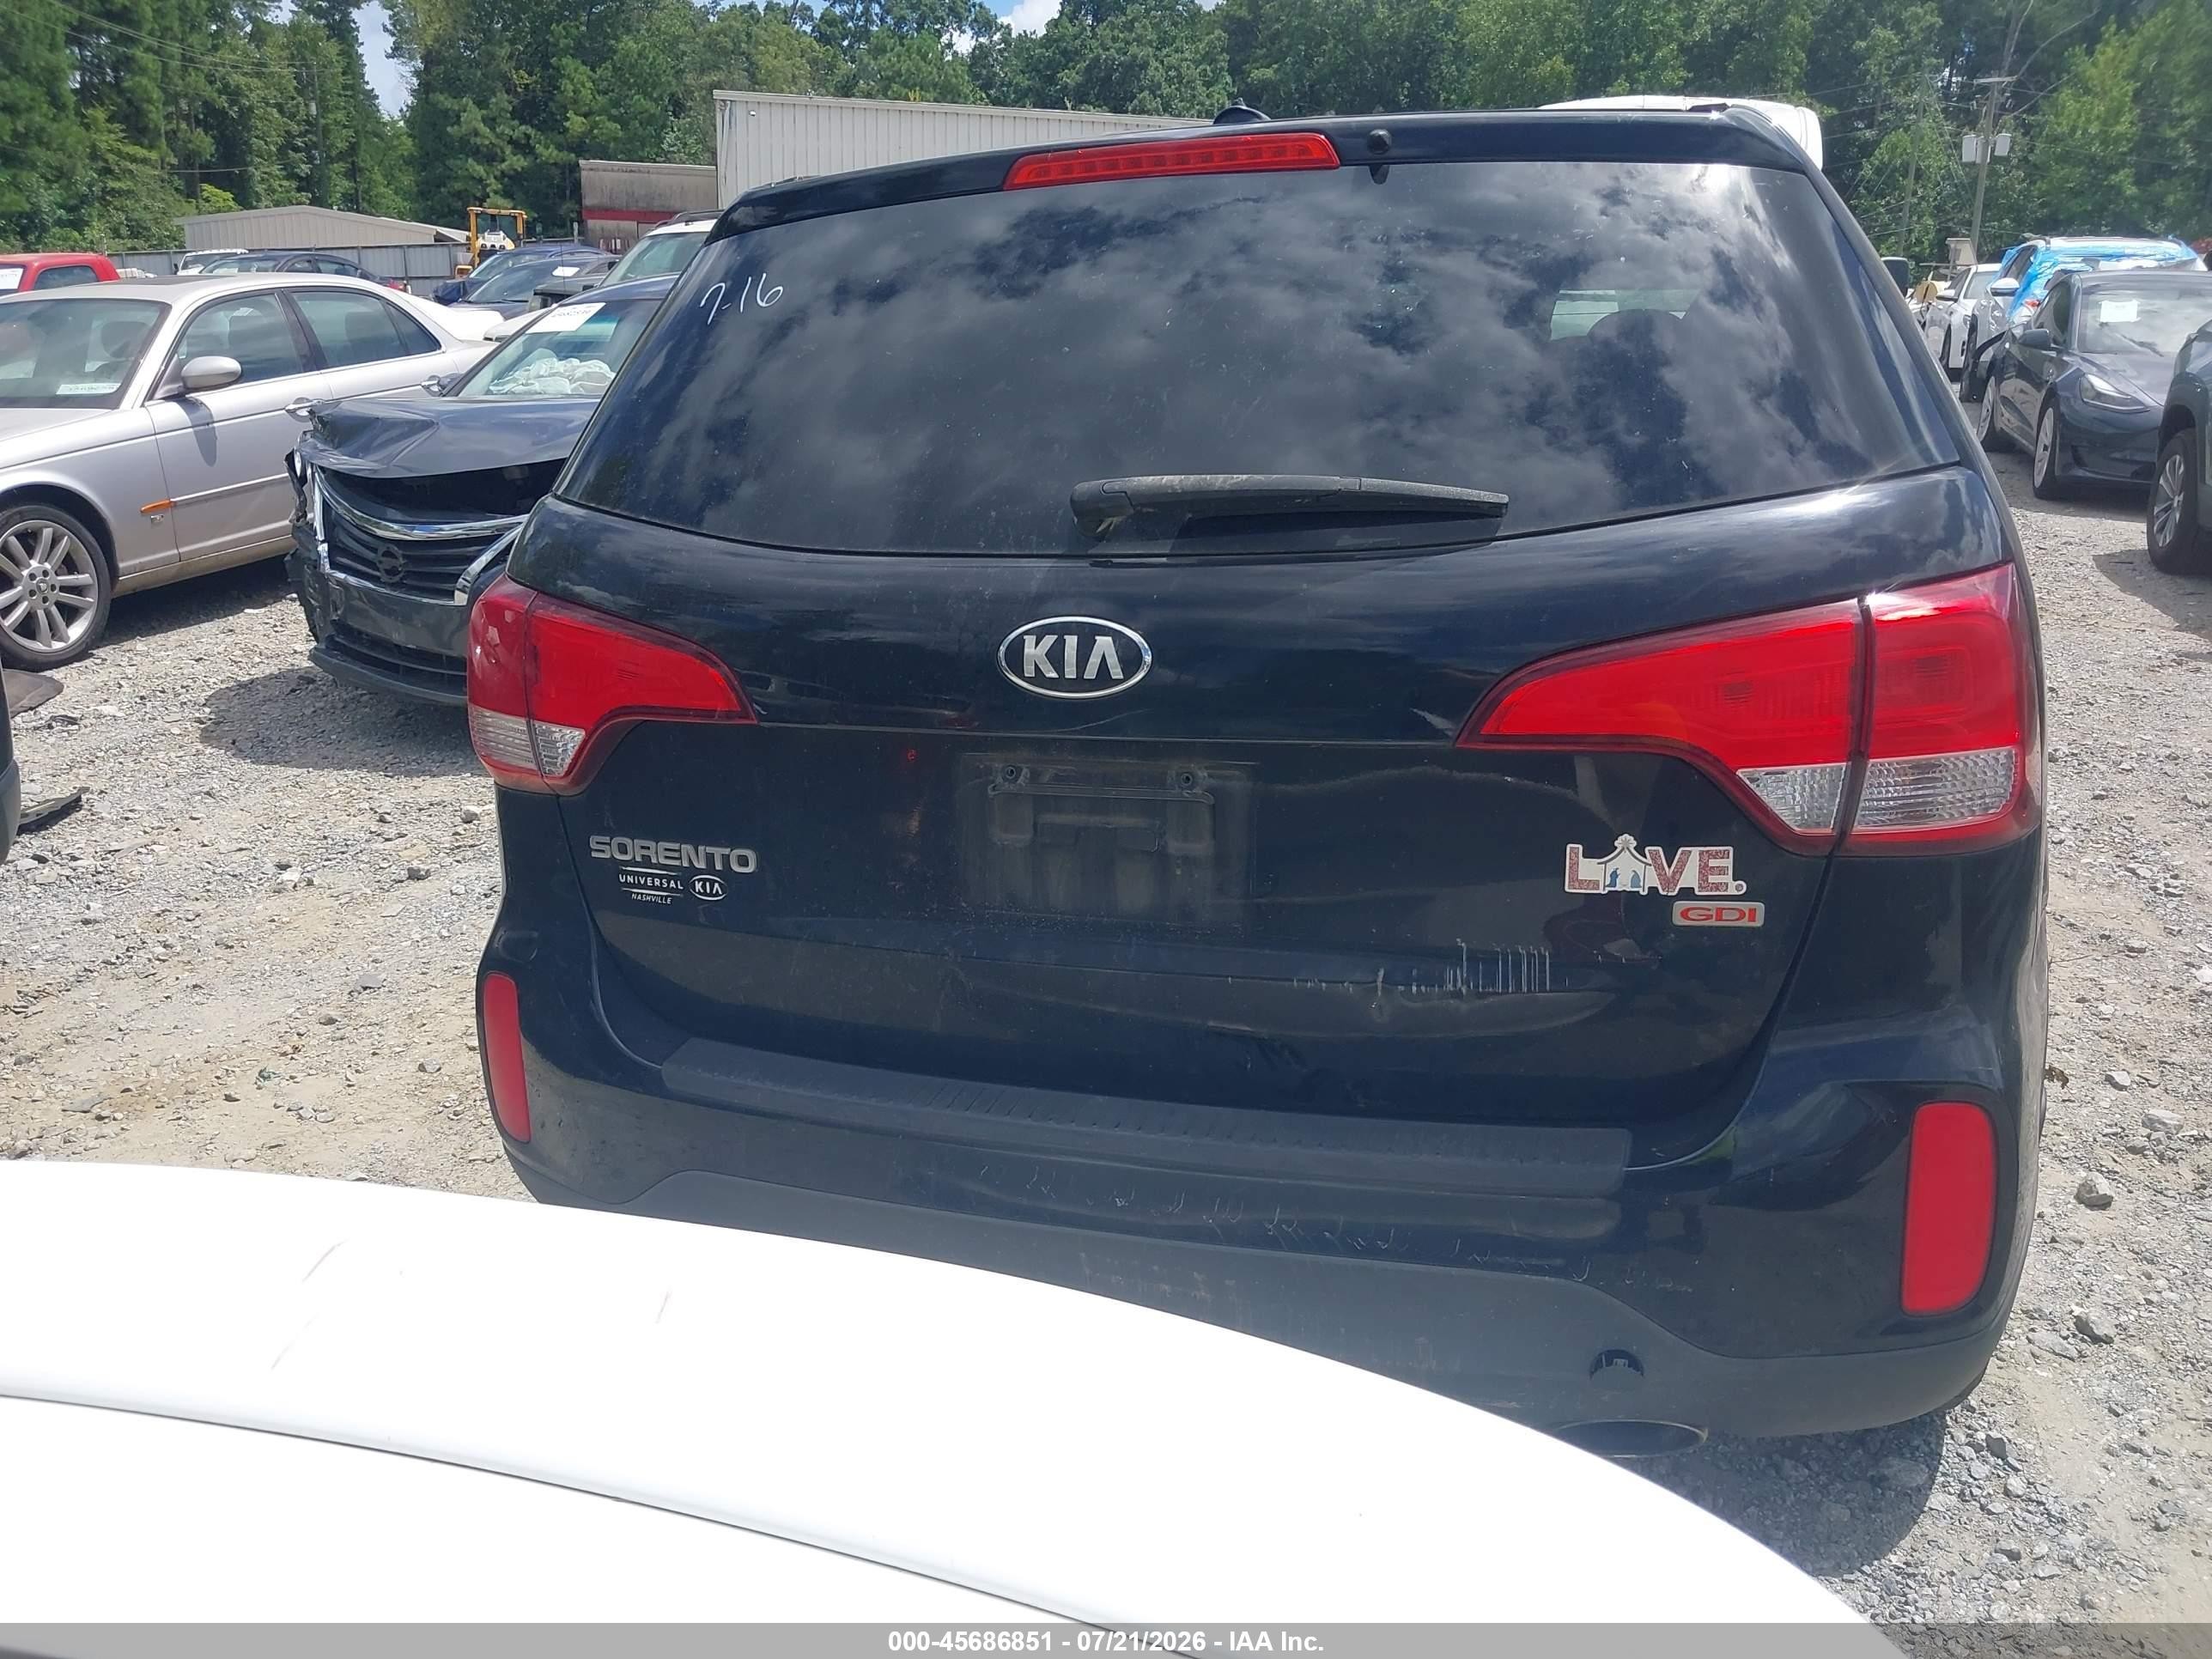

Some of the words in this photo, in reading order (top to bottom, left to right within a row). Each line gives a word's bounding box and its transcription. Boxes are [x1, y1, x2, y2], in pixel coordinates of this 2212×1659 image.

[700, 272, 784, 325] 7-16
[1023, 635, 1124, 679] KIA
[590, 835, 757, 873] SORENTO
[618, 873, 684, 890] UNIVERSAL
[695, 880, 723, 895] KIA
[631, 893, 672, 904] NASHVILLE
[1680, 907, 1757, 922] GDI
